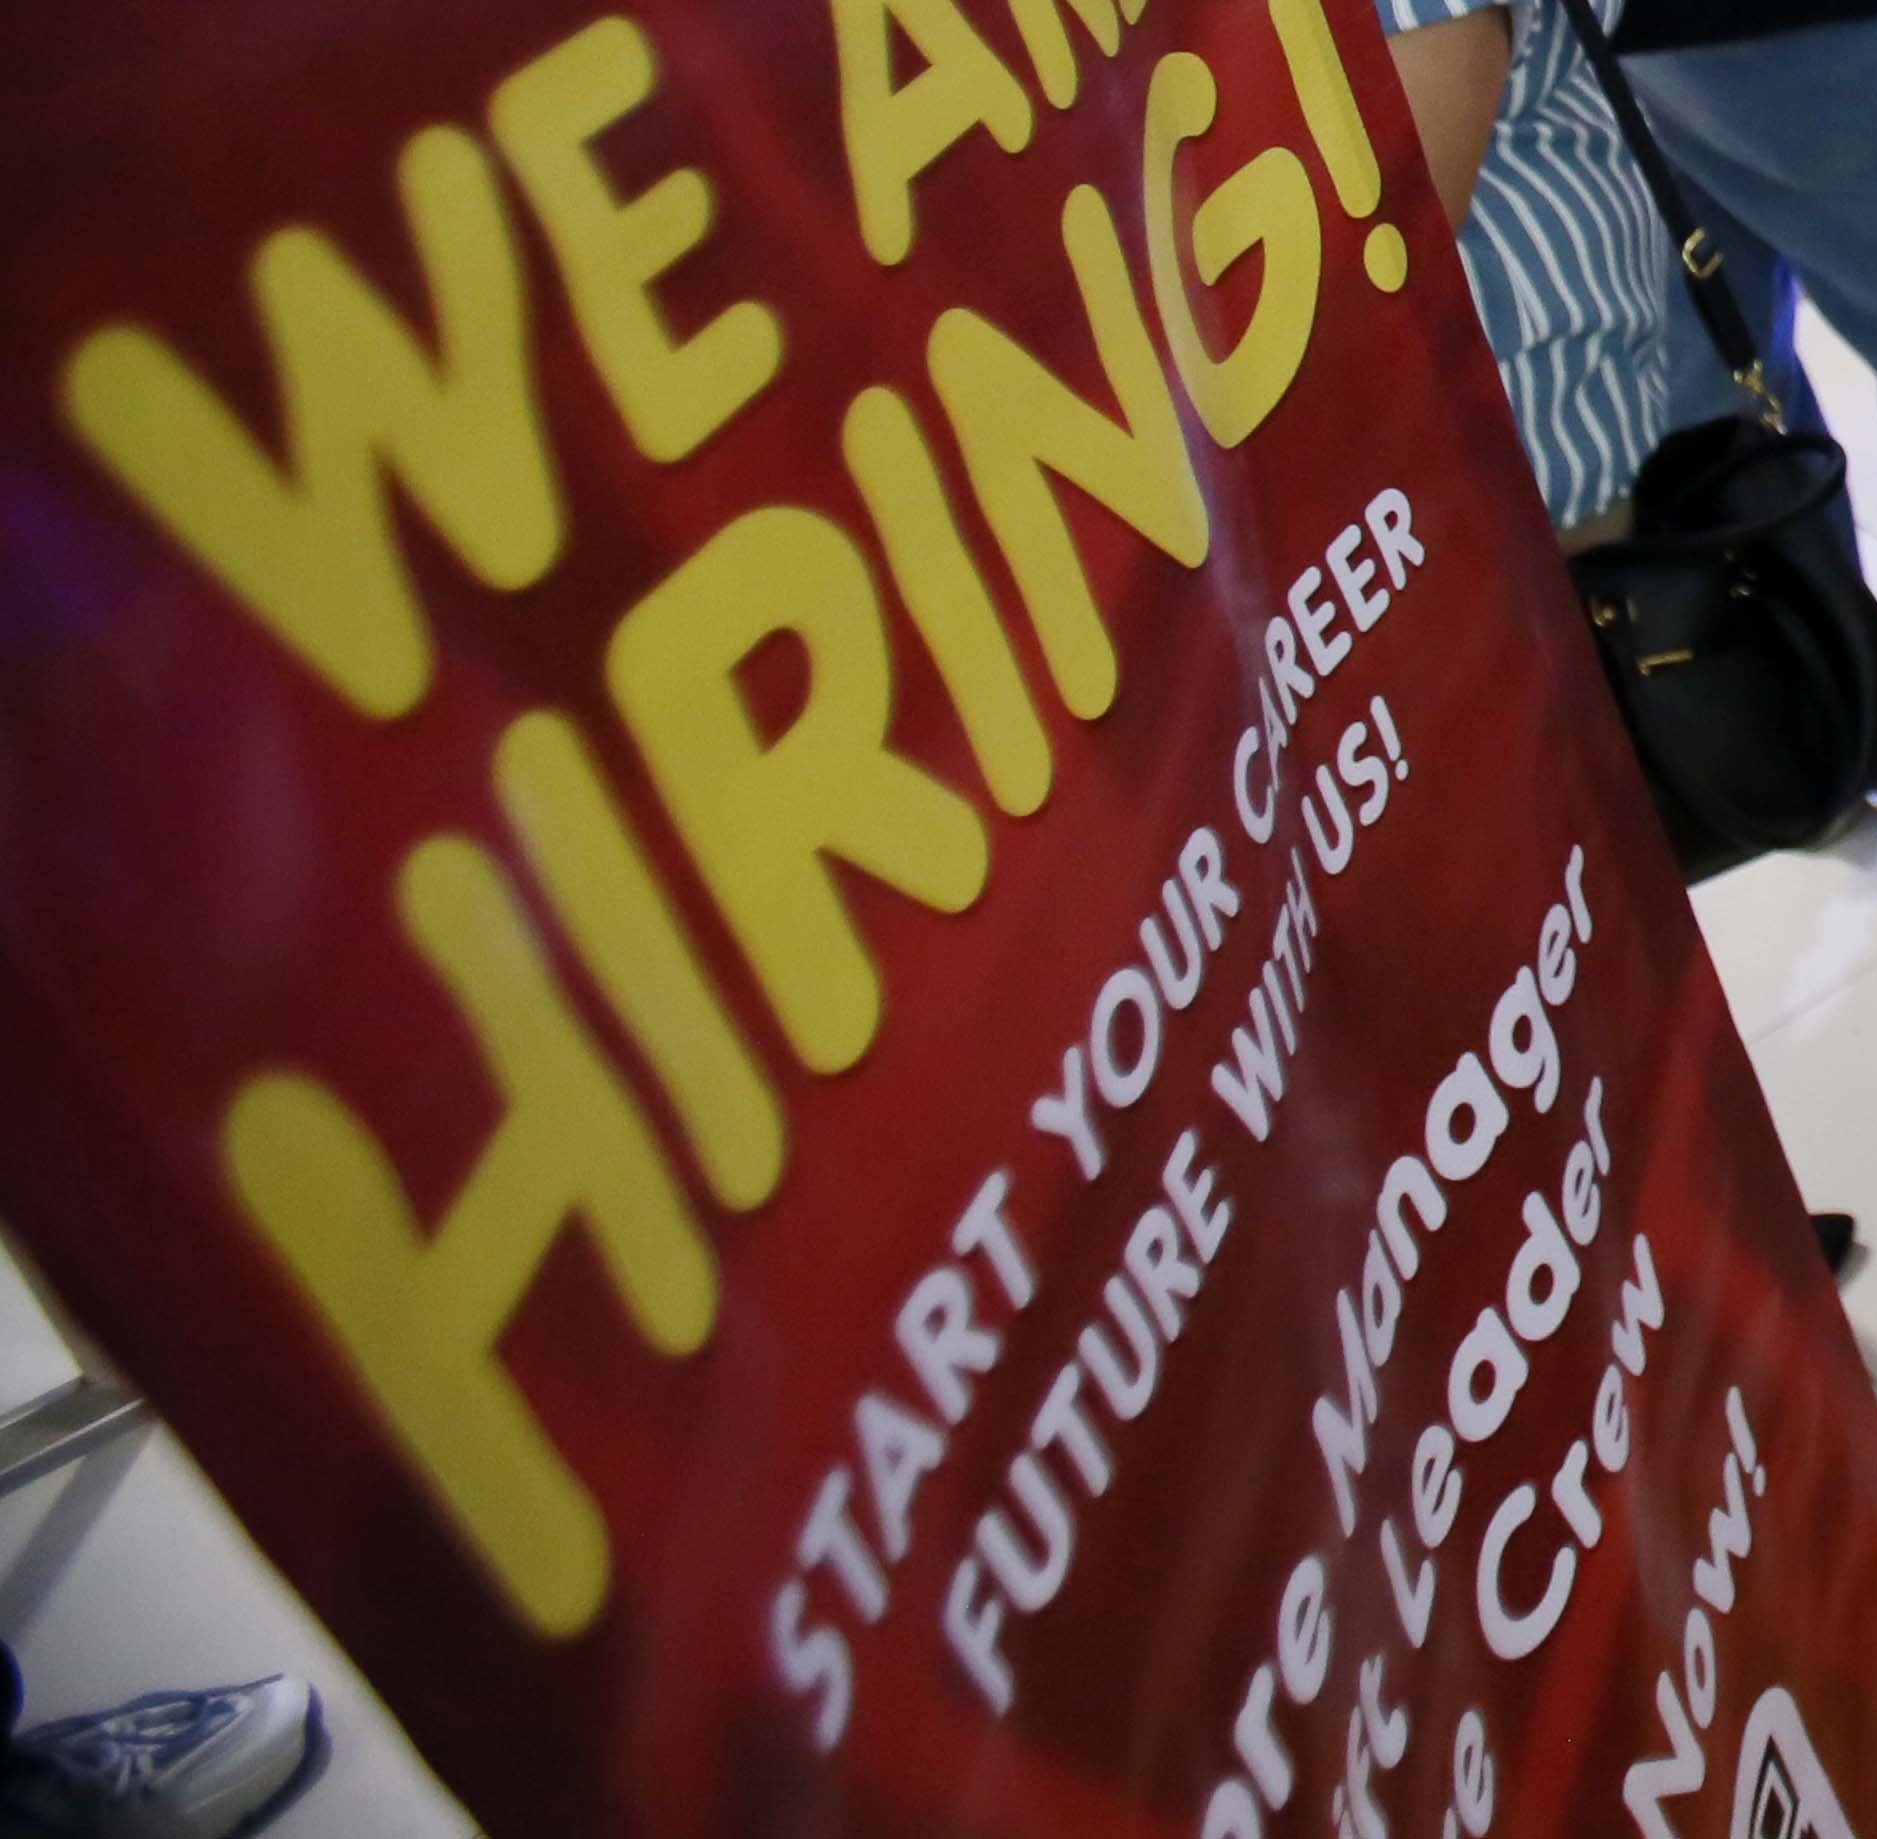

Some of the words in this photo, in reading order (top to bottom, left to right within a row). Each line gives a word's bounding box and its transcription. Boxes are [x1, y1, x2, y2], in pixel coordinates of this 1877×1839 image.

[60, 12, 787, 723] WE
[768, 1166, 1040, 1755] START
[1029, 825, 1242, 1182] YOUR
[1232, 486, 1428, 846] CAREER
[940, 1127, 1236, 1720] FUTURE
[1211, 847, 1319, 1143] WITH
[1299, 694, 1412, 876] US!
[1313, 844, 1594, 1540] Manager
[1380, 1074, 1613, 1649] Leader
[1476, 1233, 1665, 1660] Crew
[1622, 1386, 1767, 1839] Now!
